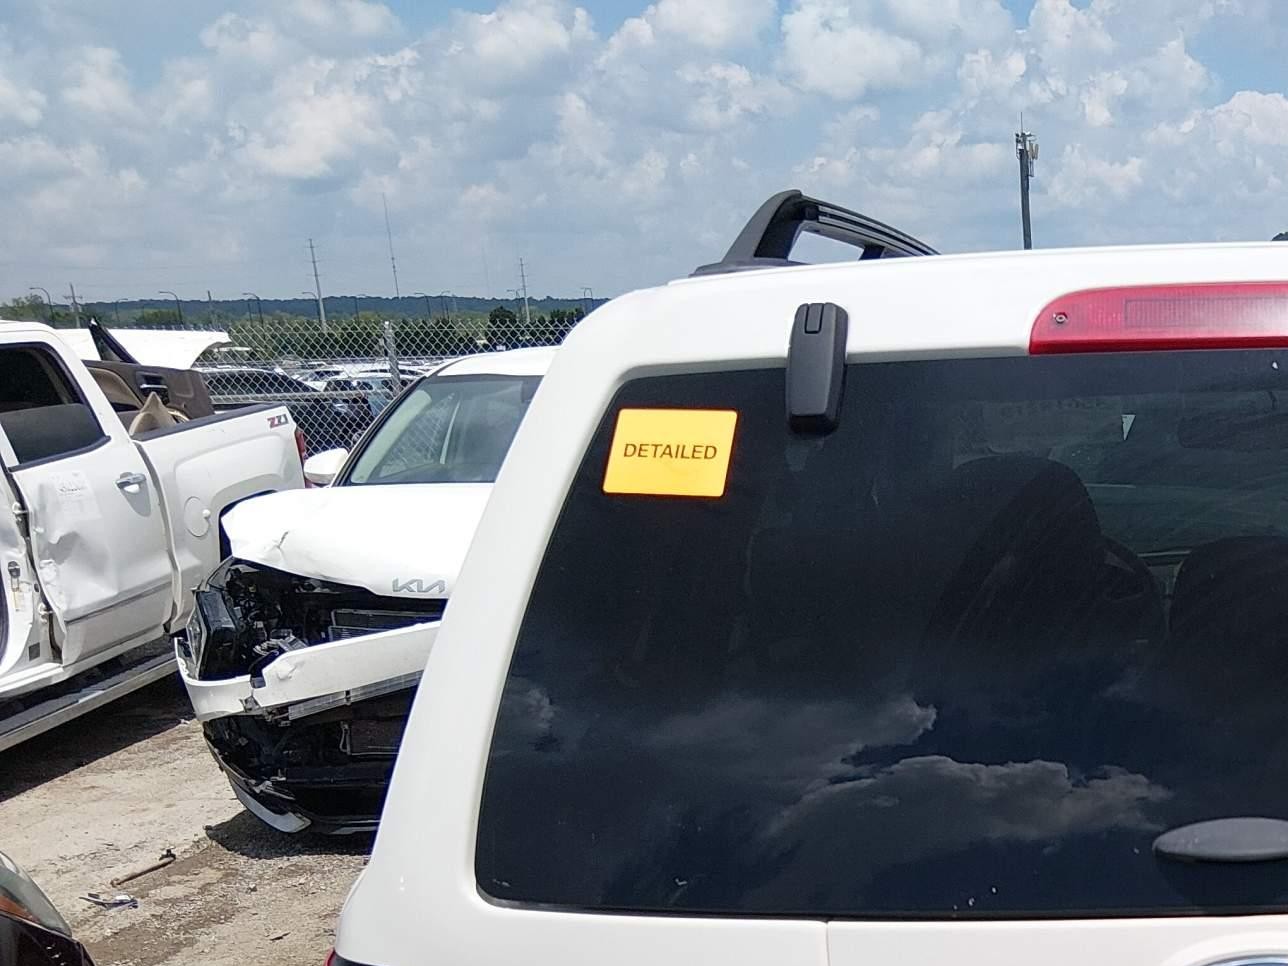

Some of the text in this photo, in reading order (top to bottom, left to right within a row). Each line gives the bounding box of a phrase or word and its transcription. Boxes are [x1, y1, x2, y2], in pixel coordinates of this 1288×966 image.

[266, 413, 289, 429] Z71
[623, 443, 718, 460] DETAILED
[392, 577, 446, 593] KIA
